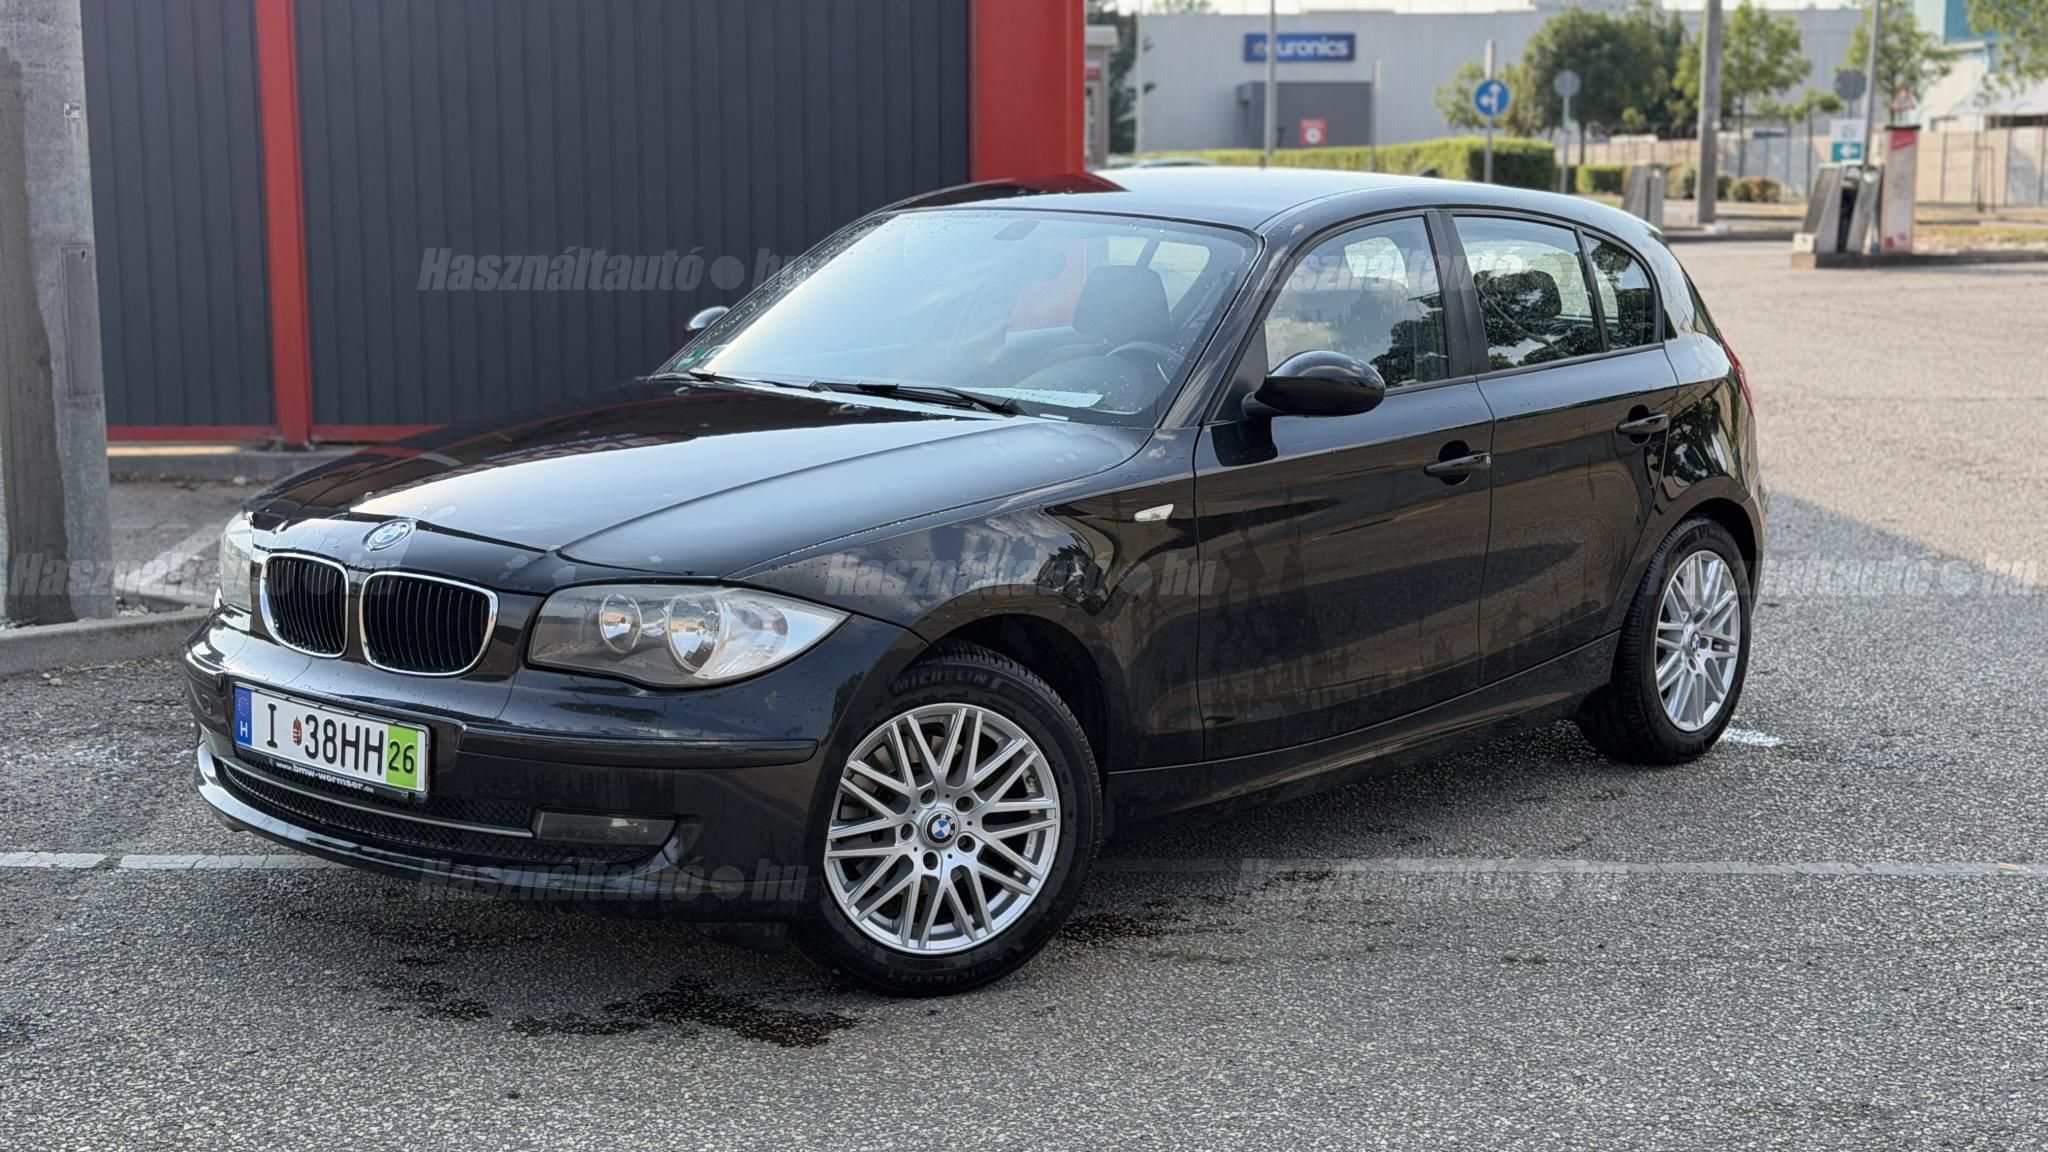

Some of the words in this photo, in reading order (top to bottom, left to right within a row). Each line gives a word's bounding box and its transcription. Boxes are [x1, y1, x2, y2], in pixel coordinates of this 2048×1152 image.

[892, 669, 990, 694] MICHELIN
[239, 720, 249, 738] H
[304, 714, 385, 776] 38HH
[388, 741, 415, 774] 26
